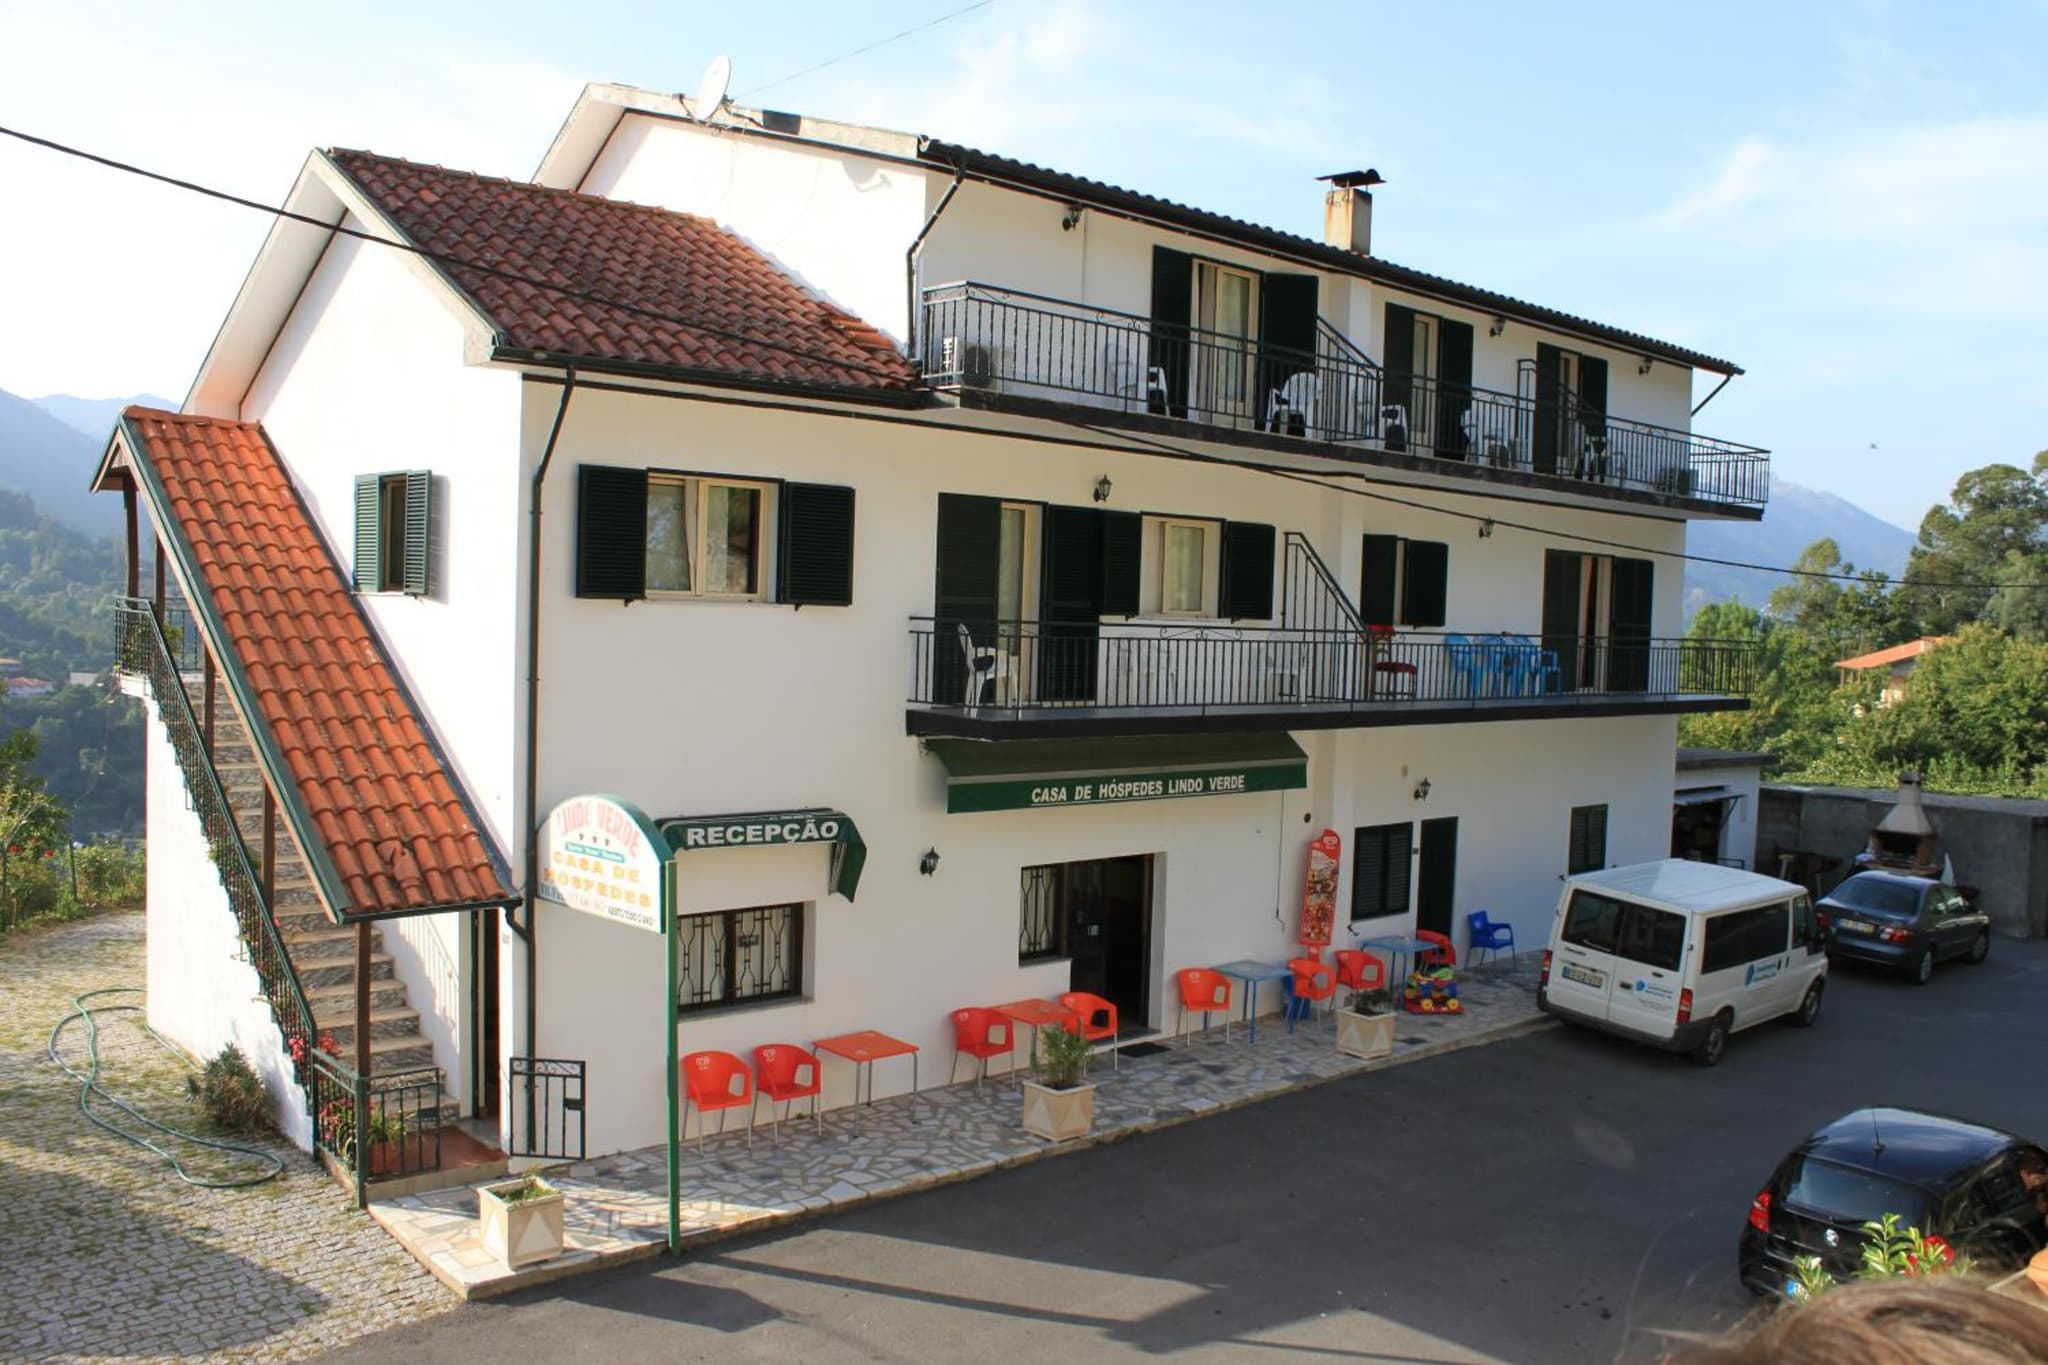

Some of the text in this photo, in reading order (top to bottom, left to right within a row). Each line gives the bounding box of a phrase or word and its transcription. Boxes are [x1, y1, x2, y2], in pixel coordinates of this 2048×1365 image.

[1031, 774, 1245, 803] CASA DE HÓSPEDES LINDO VERDE
[686, 816, 840, 846] RECEPÇÃO
[553, 850, 605, 875] CASA
[612, 865, 640, 883] DE
